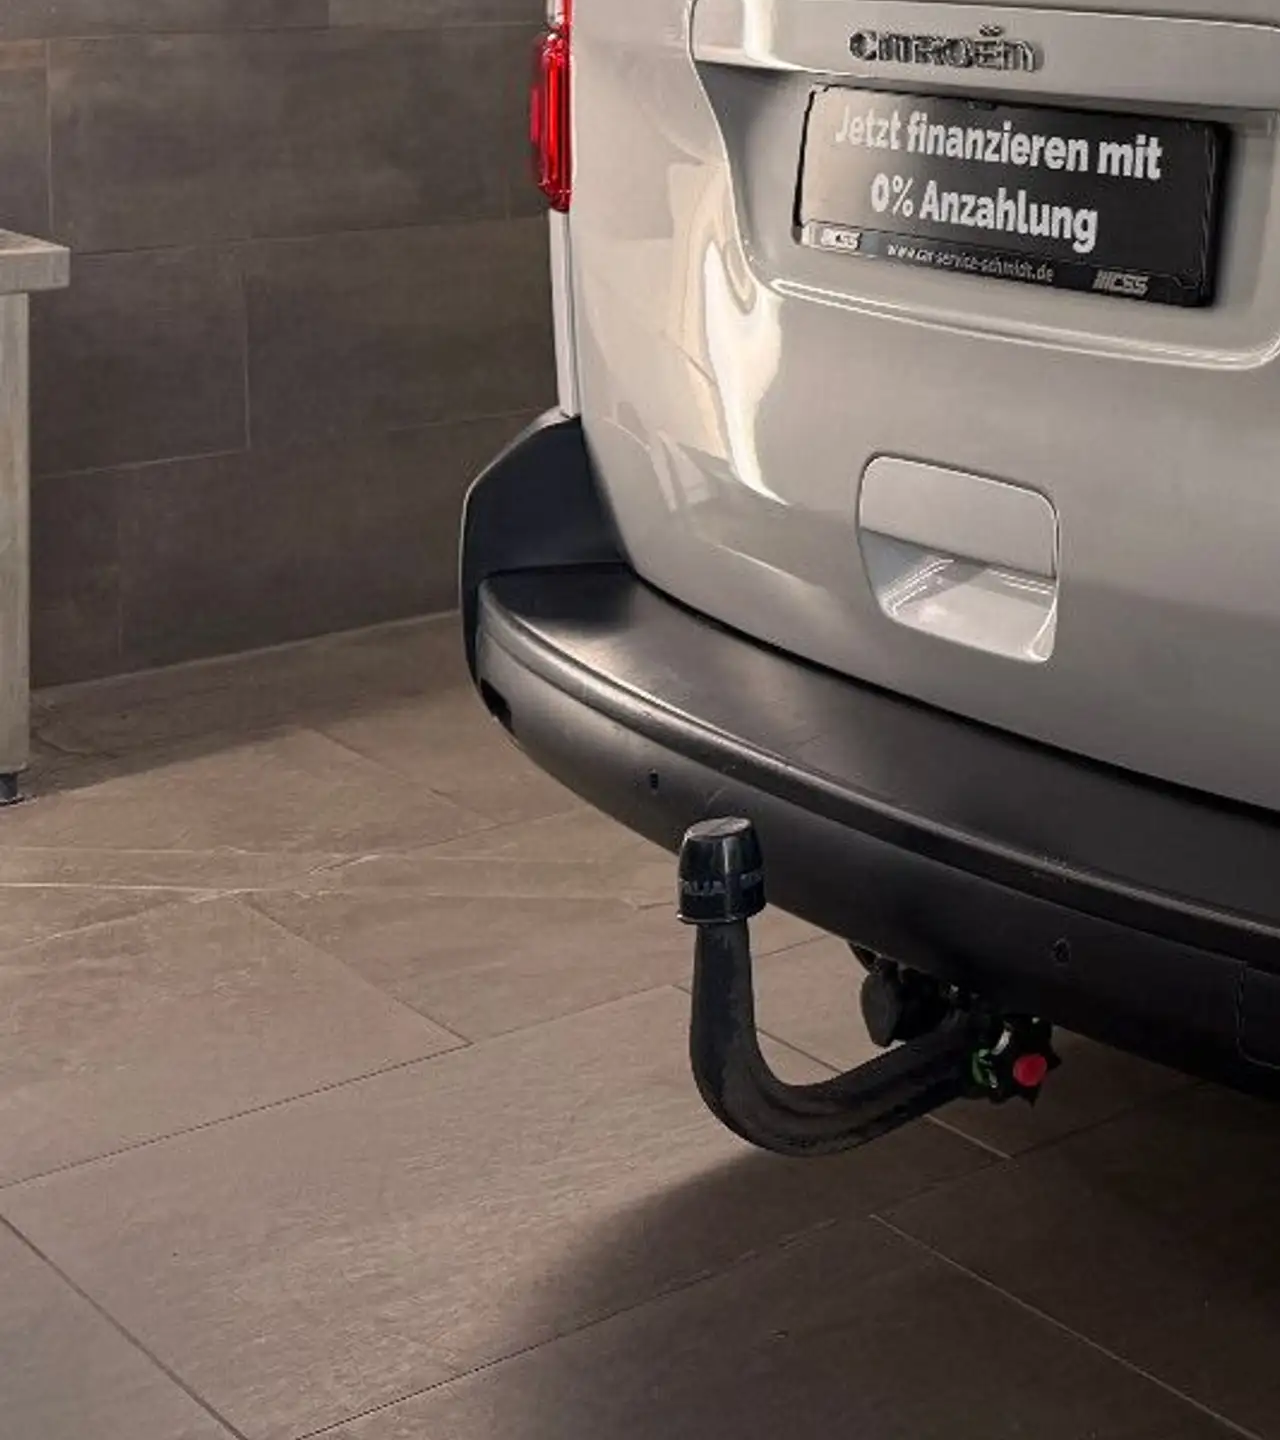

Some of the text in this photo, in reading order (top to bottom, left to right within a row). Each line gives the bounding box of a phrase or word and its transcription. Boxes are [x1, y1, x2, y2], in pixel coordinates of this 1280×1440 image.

[834, 106, 1163, 181] Jetzt finanzieren mit
[870, 171, 1100, 254] 0% Anzahlung
